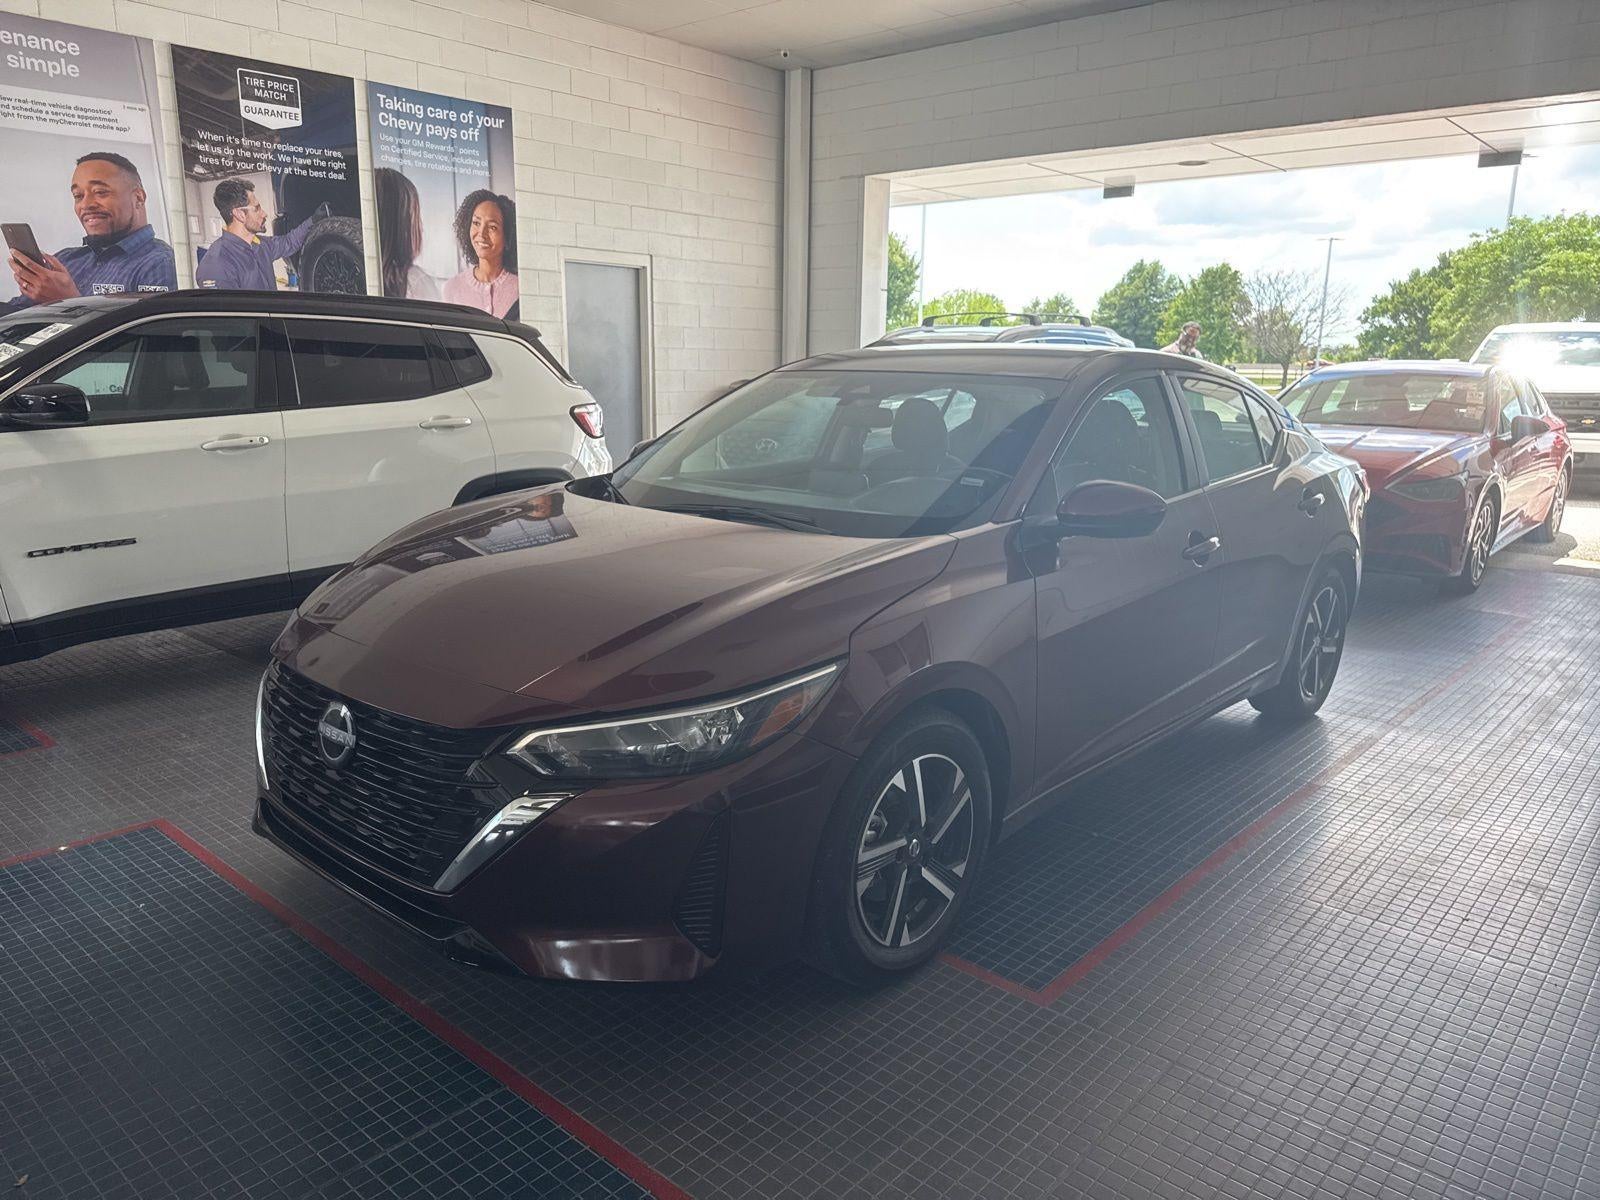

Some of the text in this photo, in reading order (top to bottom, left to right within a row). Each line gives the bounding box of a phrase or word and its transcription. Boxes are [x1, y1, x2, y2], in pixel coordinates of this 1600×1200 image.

[0, 30, 80, 56] enance
[7, 51, 80, 78] simple
[244, 77, 295, 93] TIRE PRICE
[254, 88, 287, 101] MATCH
[14, 98, 47, 107] real-time
[244, 105, 300, 122] GUARANTEE
[376, 93, 505, 129] Taking care of your
[11, 105, 44, 114] schedule
[50, 110, 76, 119] service
[76, 114, 118, 124] appointment
[16, 112, 34, 121] from
[48, 118, 91, 128] myChevrolet
[92, 123, 115, 131] mobile
[378, 112, 480, 142] Chevy pays off
[197, 130, 344, 160] When it's time to replace your tires,
[379, 132, 394, 143] Use
[411, 138, 425, 147] GM
[197, 140, 347, 170] let us do the work. We have the right
[199, 154, 347, 181] tires for your Chevy at the best deal.
